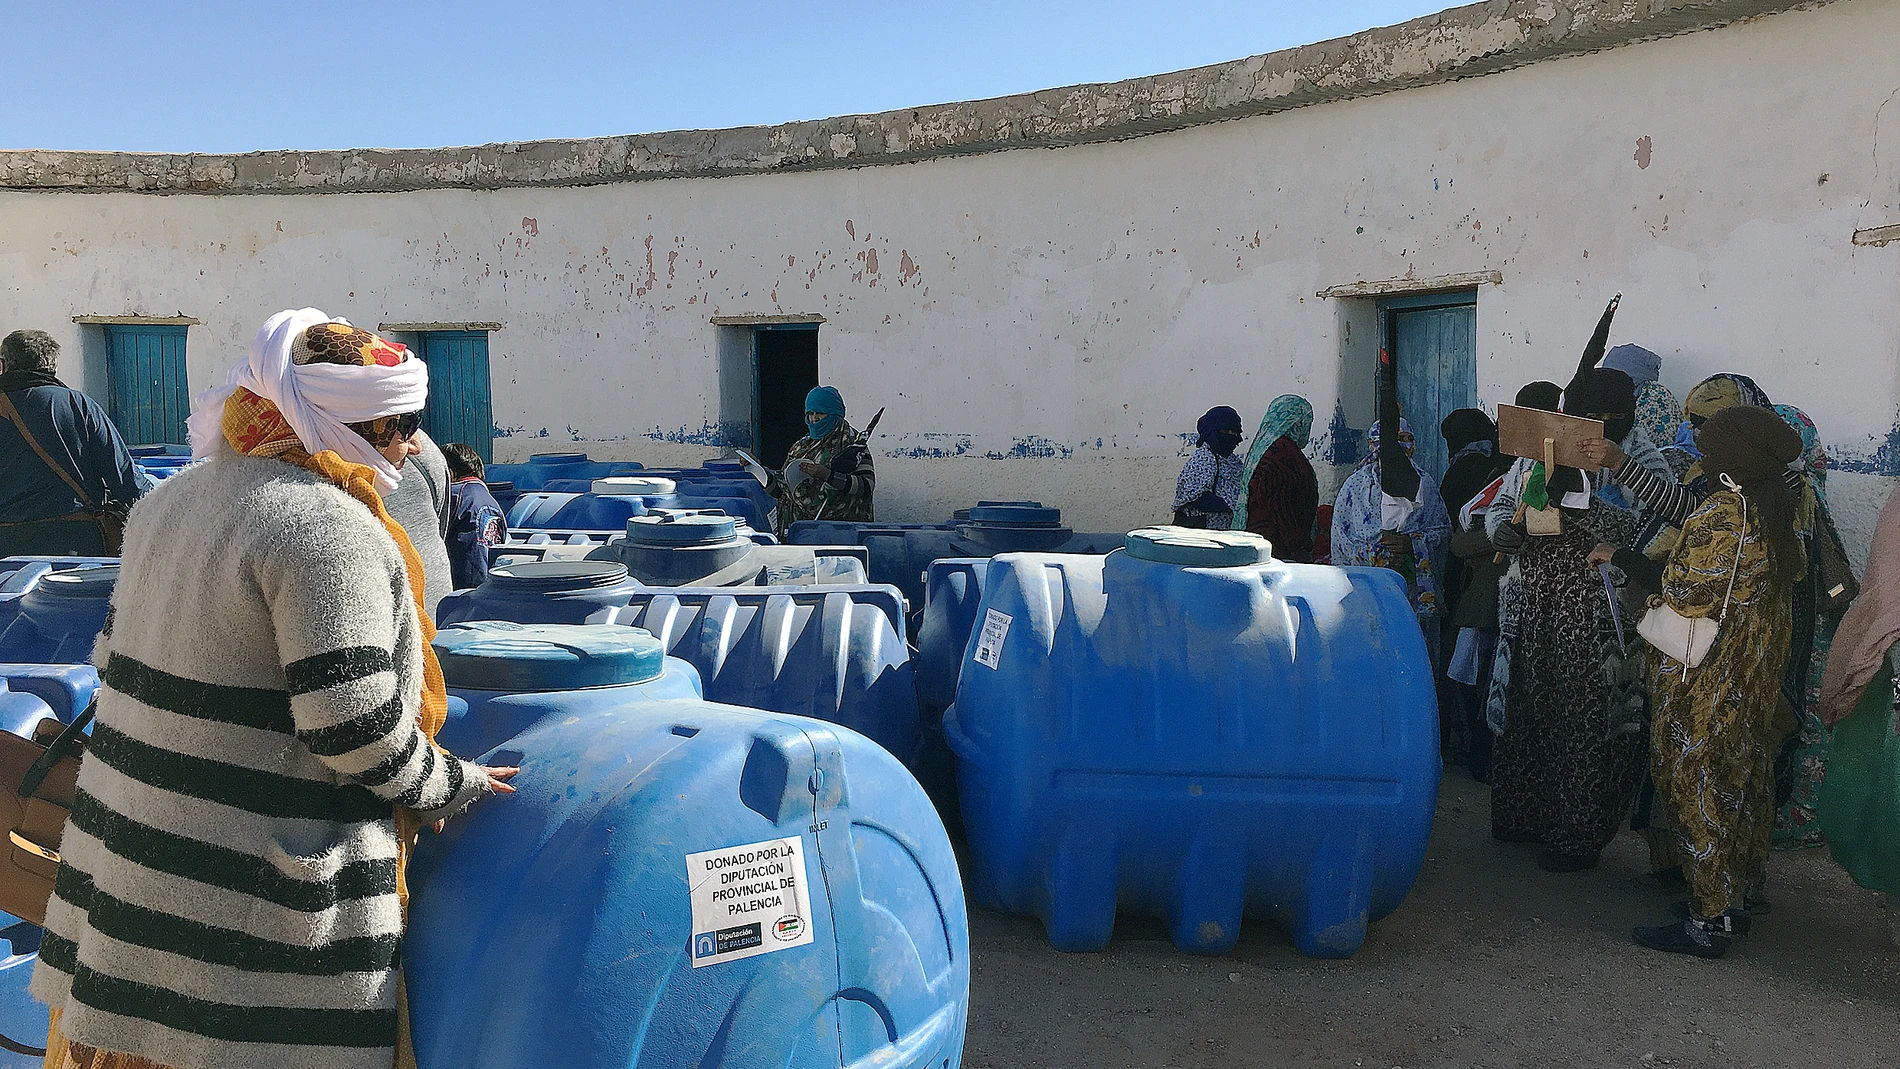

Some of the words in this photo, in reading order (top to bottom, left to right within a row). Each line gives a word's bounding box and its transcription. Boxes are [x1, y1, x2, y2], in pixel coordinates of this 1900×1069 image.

[705, 852, 754, 870] DONADO
[756, 848, 778, 861] POR
[780, 845, 795, 857] LA
[720, 861, 784, 885] DIPUTACIÓN
[712, 880, 778, 903] PROVINCIAL
[780, 876, 795, 889] DE
[728, 895, 782, 916] PALENCIA
[718, 928, 753, 941] Diputación
[718, 942, 729, 950] DE
[729, 935, 761, 948] PALENCIA
